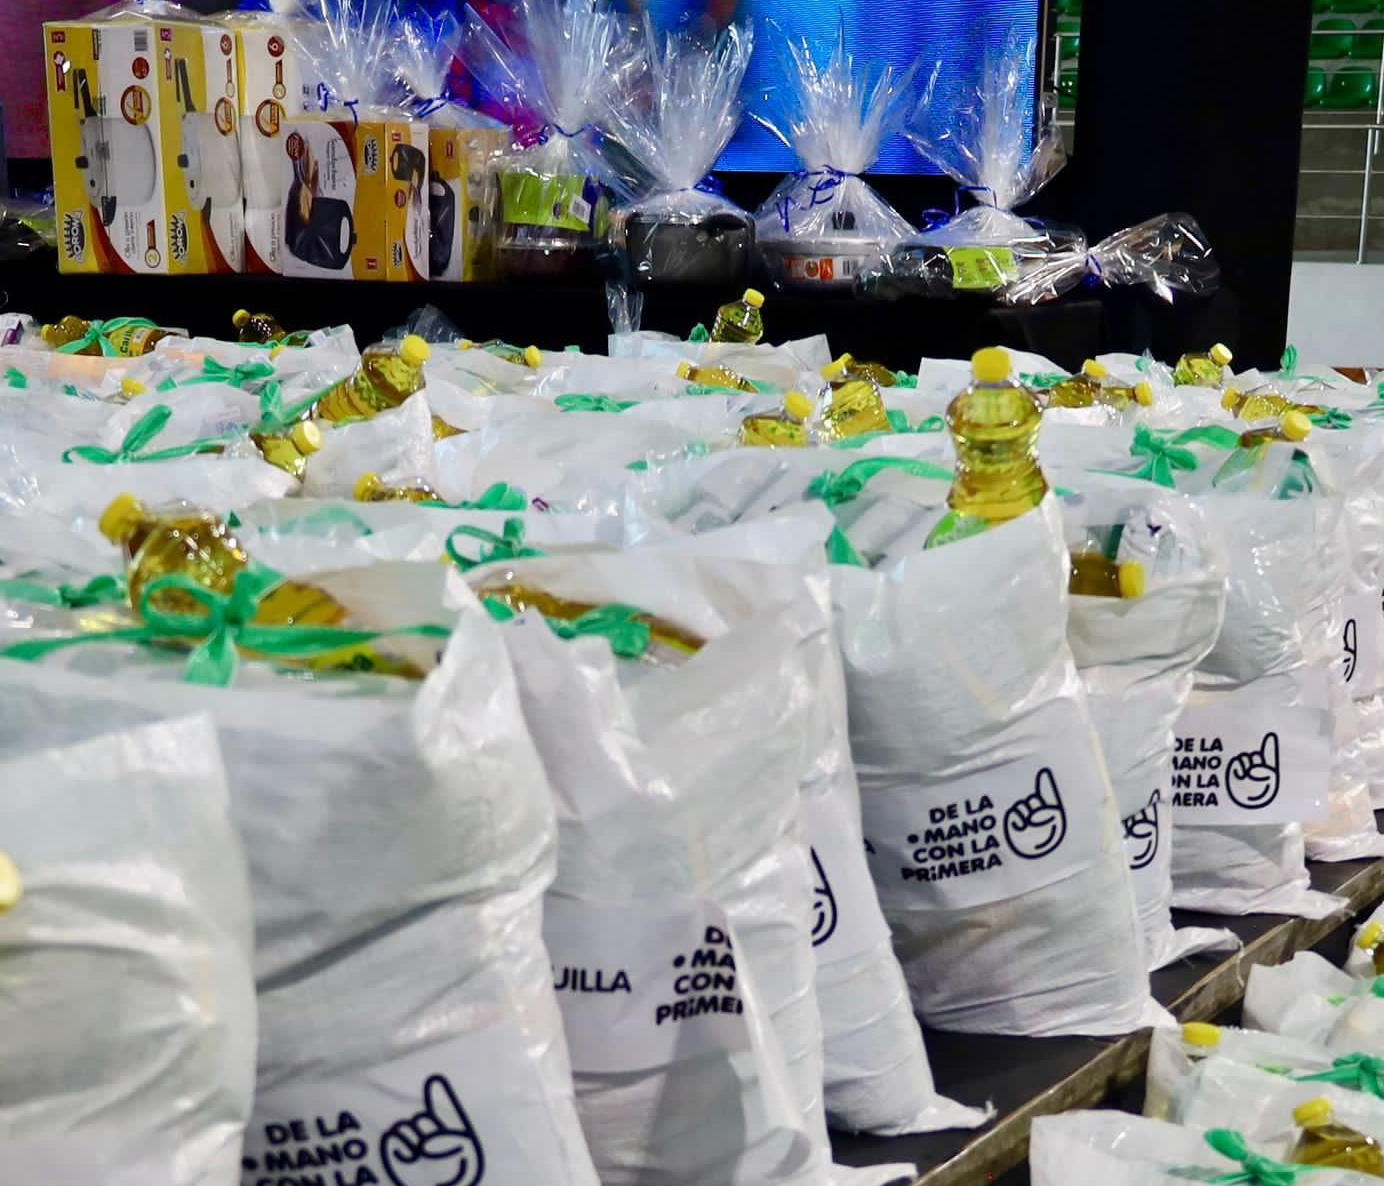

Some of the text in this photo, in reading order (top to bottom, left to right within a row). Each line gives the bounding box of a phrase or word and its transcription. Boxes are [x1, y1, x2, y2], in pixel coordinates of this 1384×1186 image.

[1175, 738, 1223, 751] DE LA
[1197, 775, 1219, 788] LA
[929, 795, 994, 824] DE LA
[924, 815, 997, 844] MANO
[913, 834, 1000, 864] CON LA
[691, 949, 736, 969] MA
[674, 973, 735, 995] CON
[265, 1110, 361, 1145] DE LA
[264, 1138, 368, 1172] MANO
